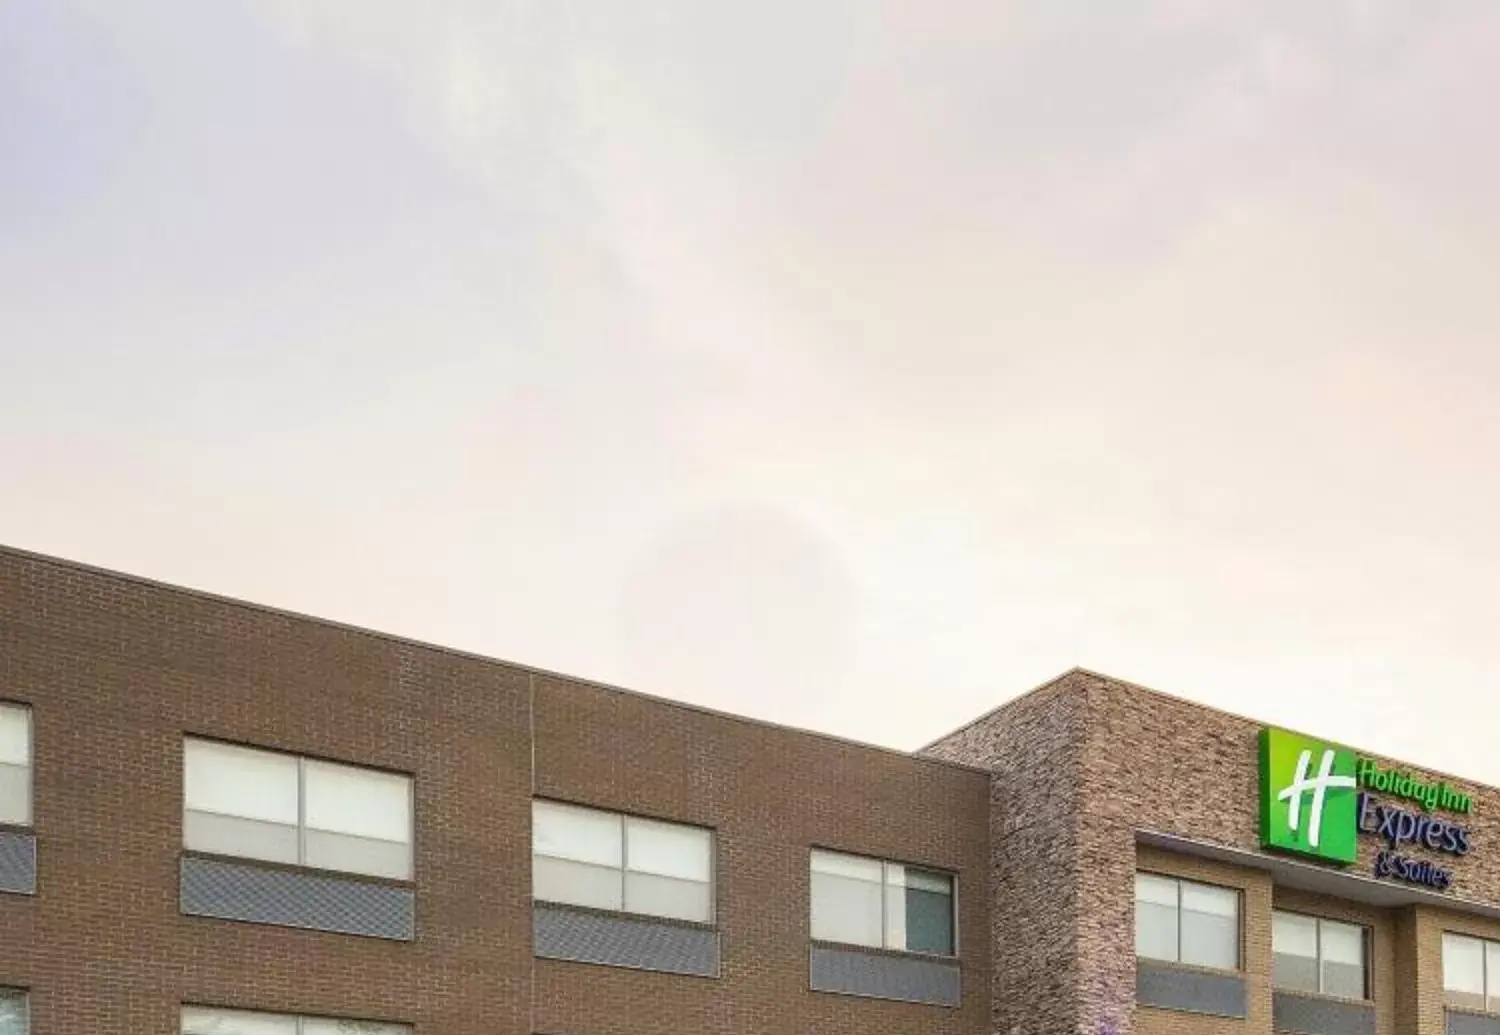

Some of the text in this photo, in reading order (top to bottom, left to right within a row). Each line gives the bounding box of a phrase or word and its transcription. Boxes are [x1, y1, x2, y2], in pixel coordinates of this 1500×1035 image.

[1277, 749, 1356, 847] H
[1357, 758, 1473, 813] Holiday Inn
[1357, 792, 1472, 855] Express
[1375, 851, 1453, 888] & Suites
